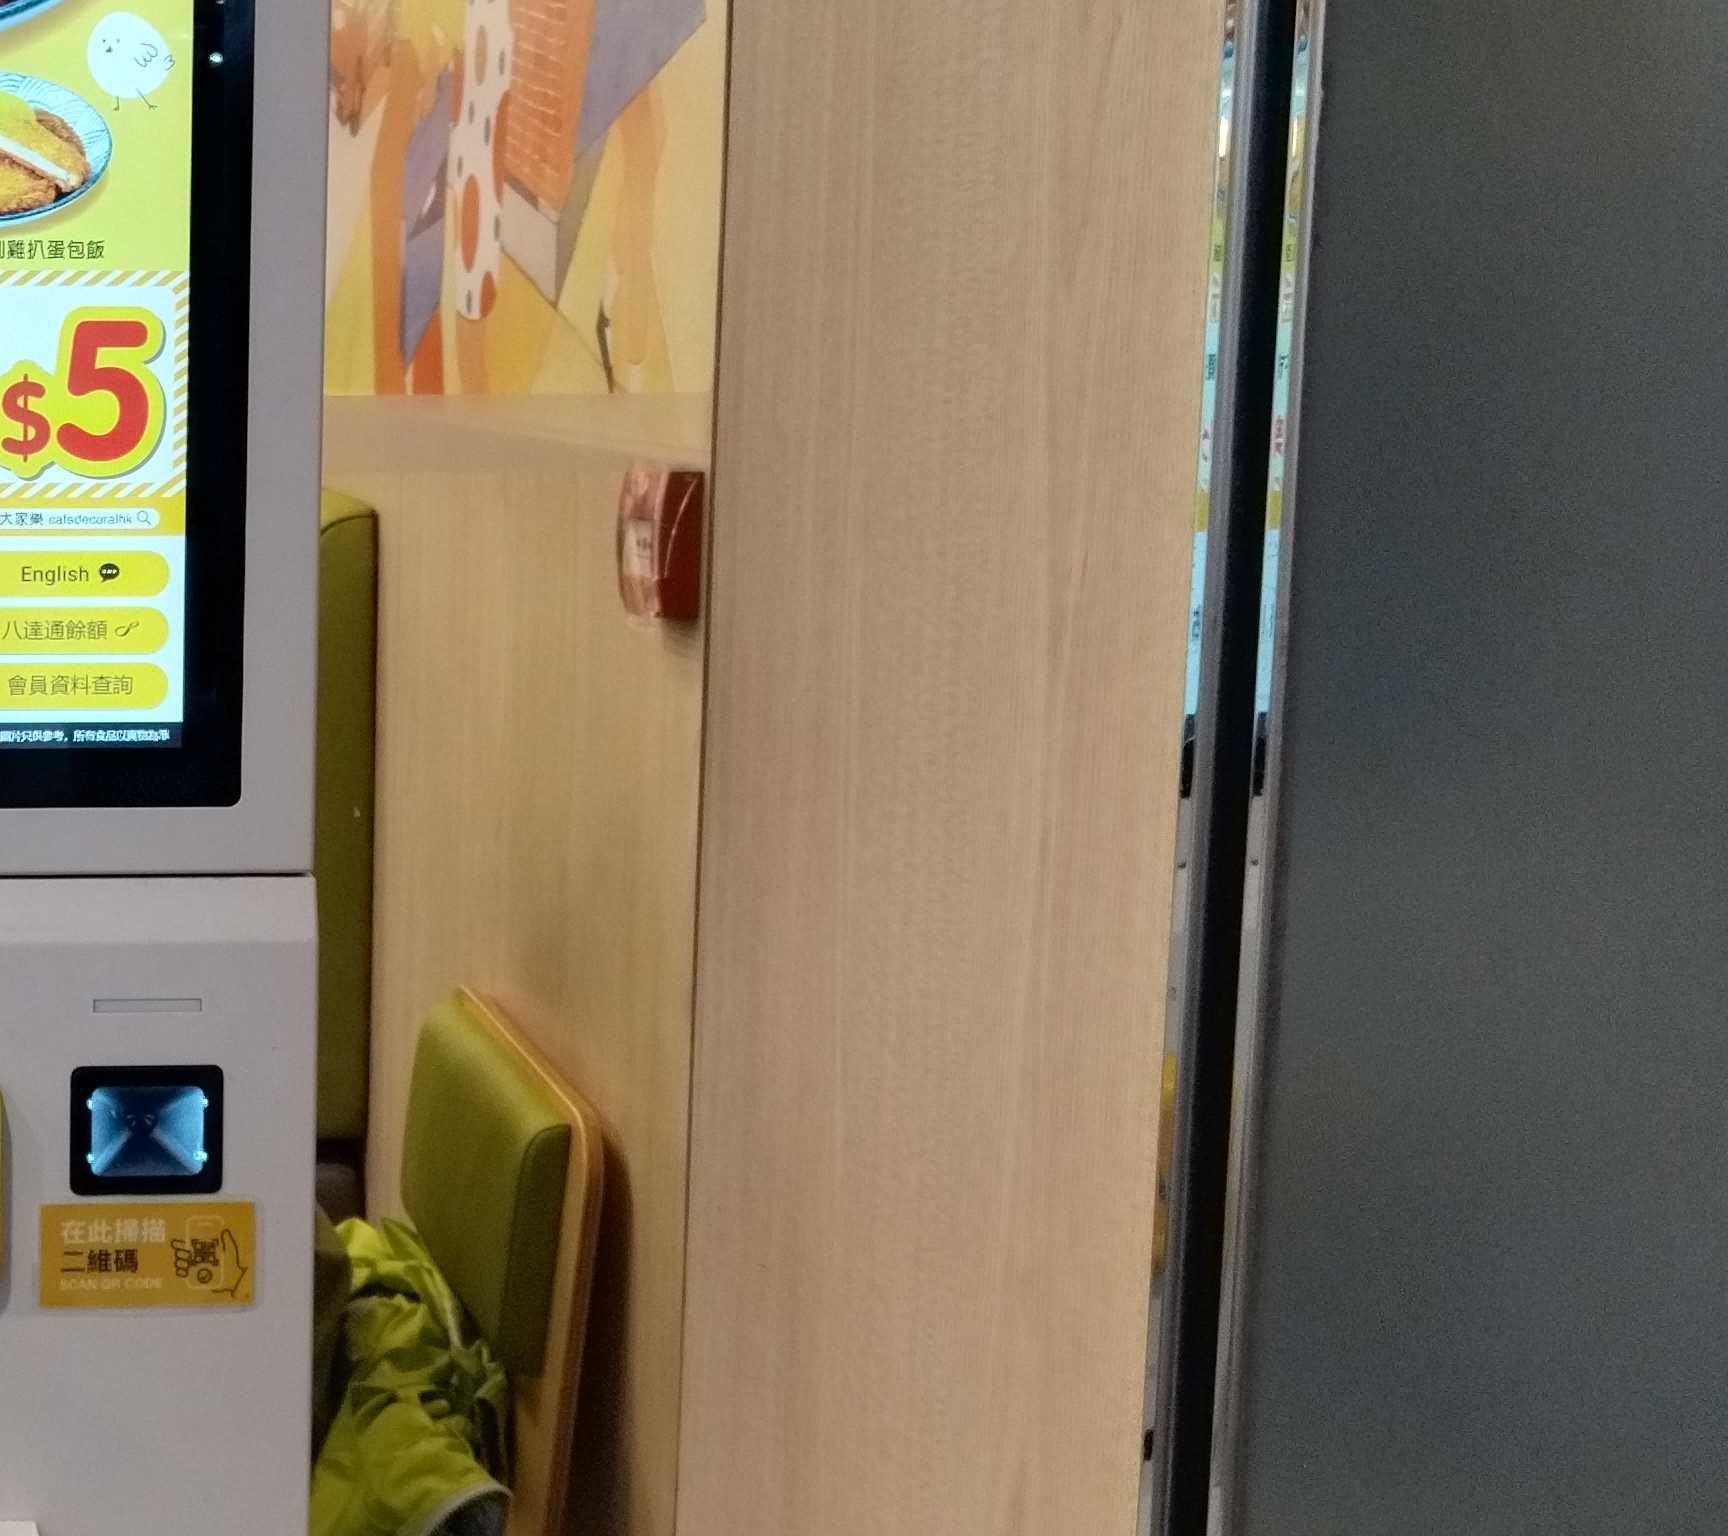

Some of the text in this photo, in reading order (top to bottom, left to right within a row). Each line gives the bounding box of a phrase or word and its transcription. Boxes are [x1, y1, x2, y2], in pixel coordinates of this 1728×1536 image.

[20, 565, 90, 586] English
[1, 619, 109, 641] 八達通餘額
[7, 673, 134, 697] 會員資料查詢
[60, 1248, 139, 1274] 二維碼
